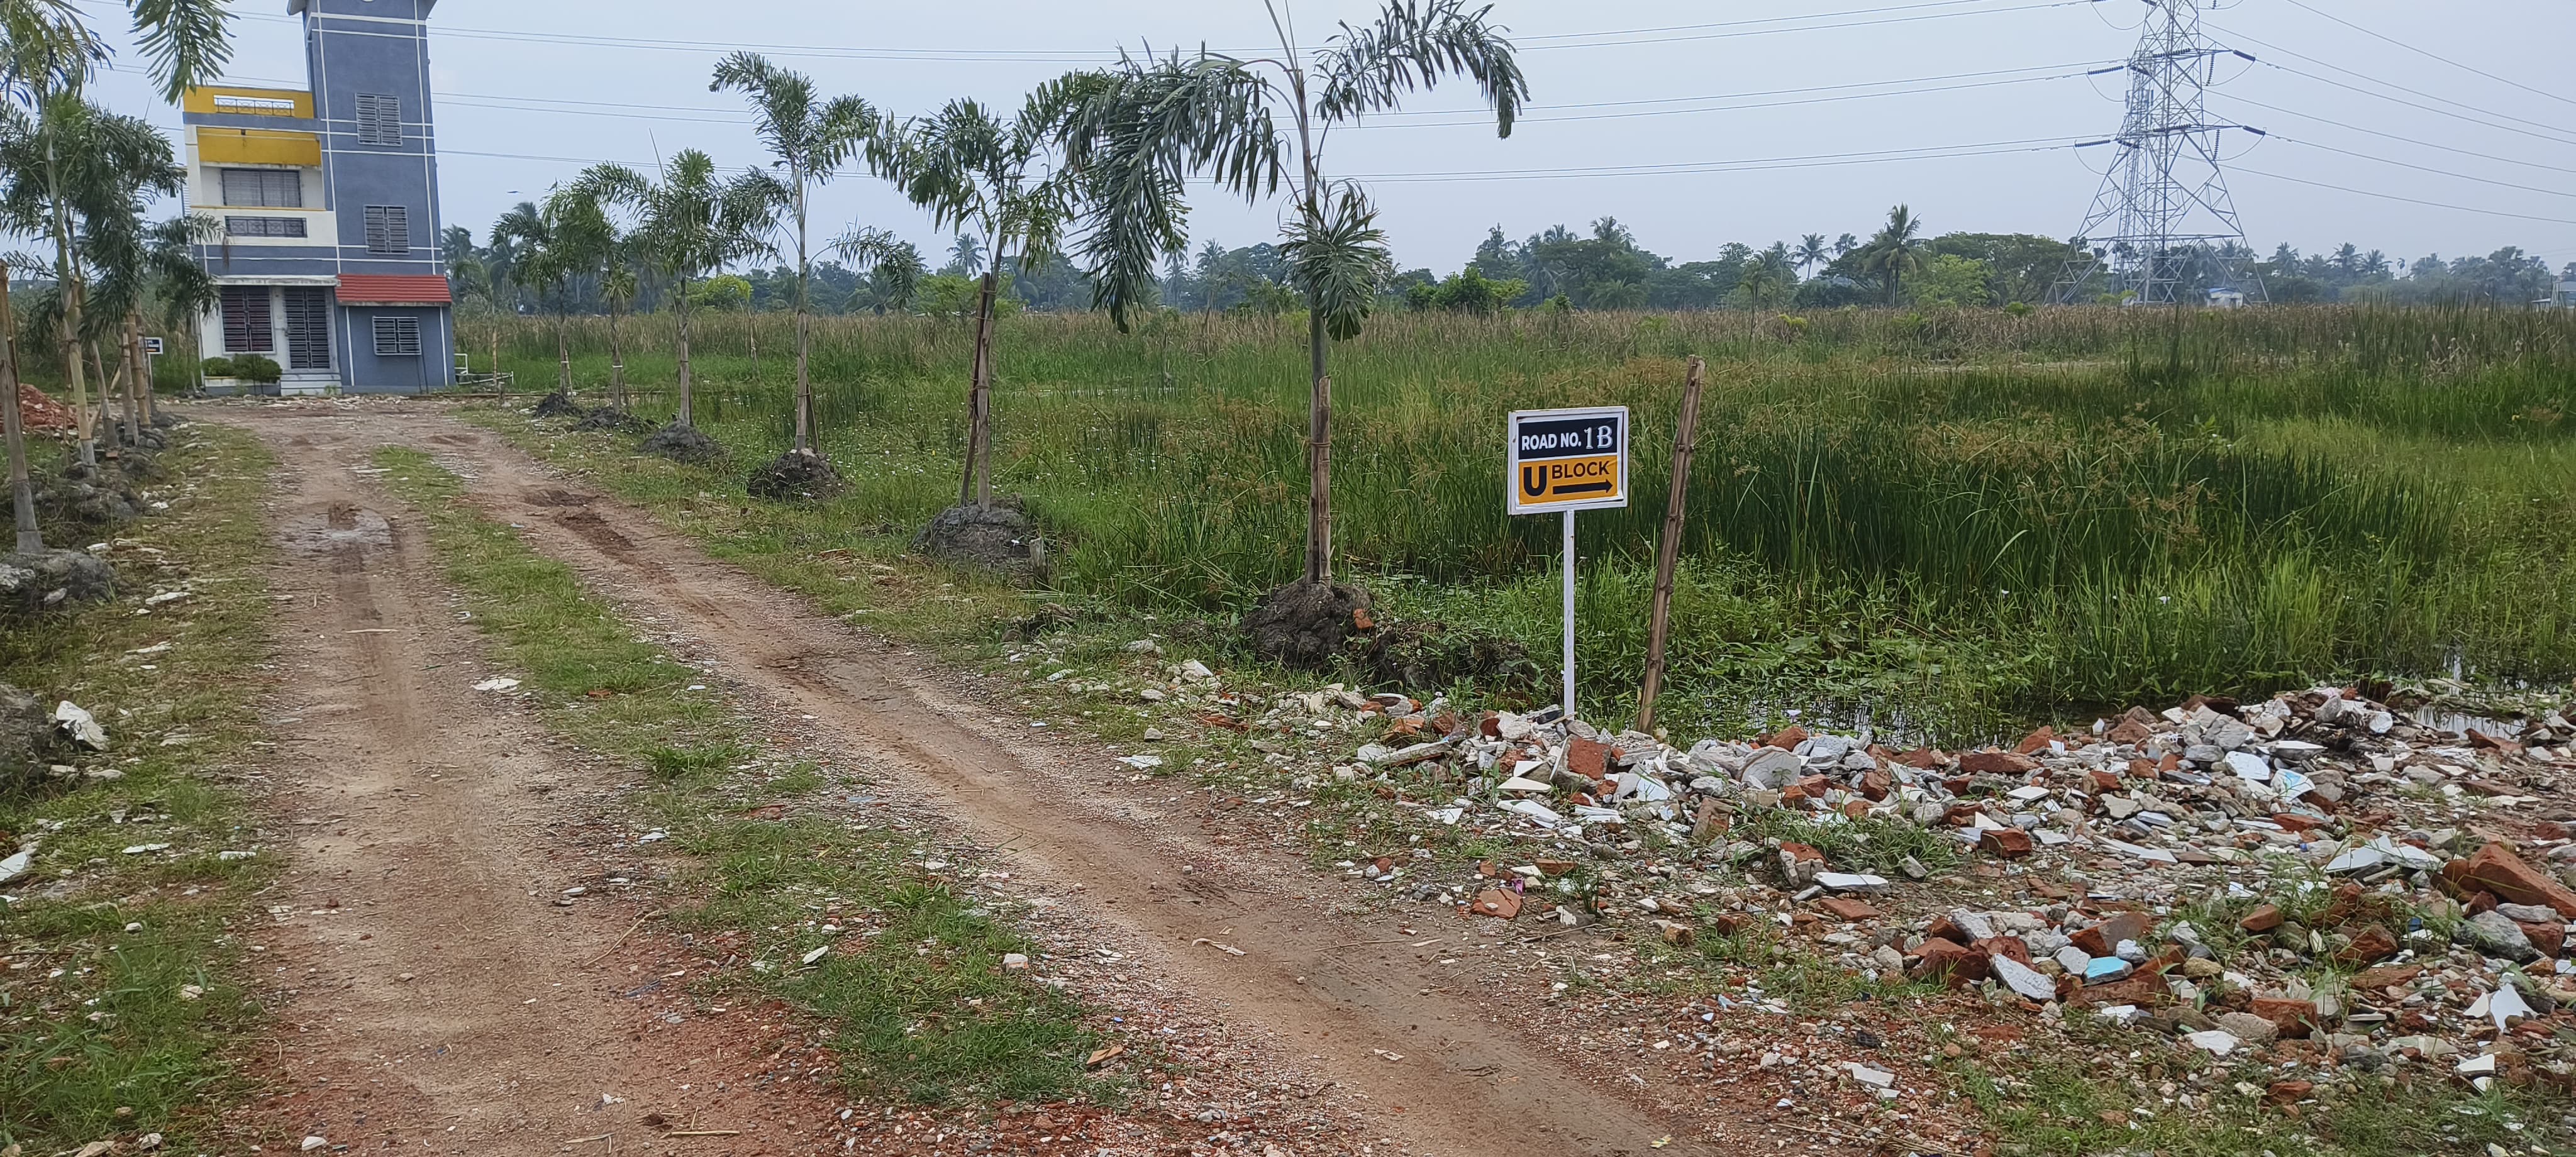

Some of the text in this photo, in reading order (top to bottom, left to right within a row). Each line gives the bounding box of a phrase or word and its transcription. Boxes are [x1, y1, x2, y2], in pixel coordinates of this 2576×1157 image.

[1521, 434, 1557, 450] ROAD
[1560, 432, 1582, 448] NO.
[1523, 460, 1610, 497] U BLOCK
